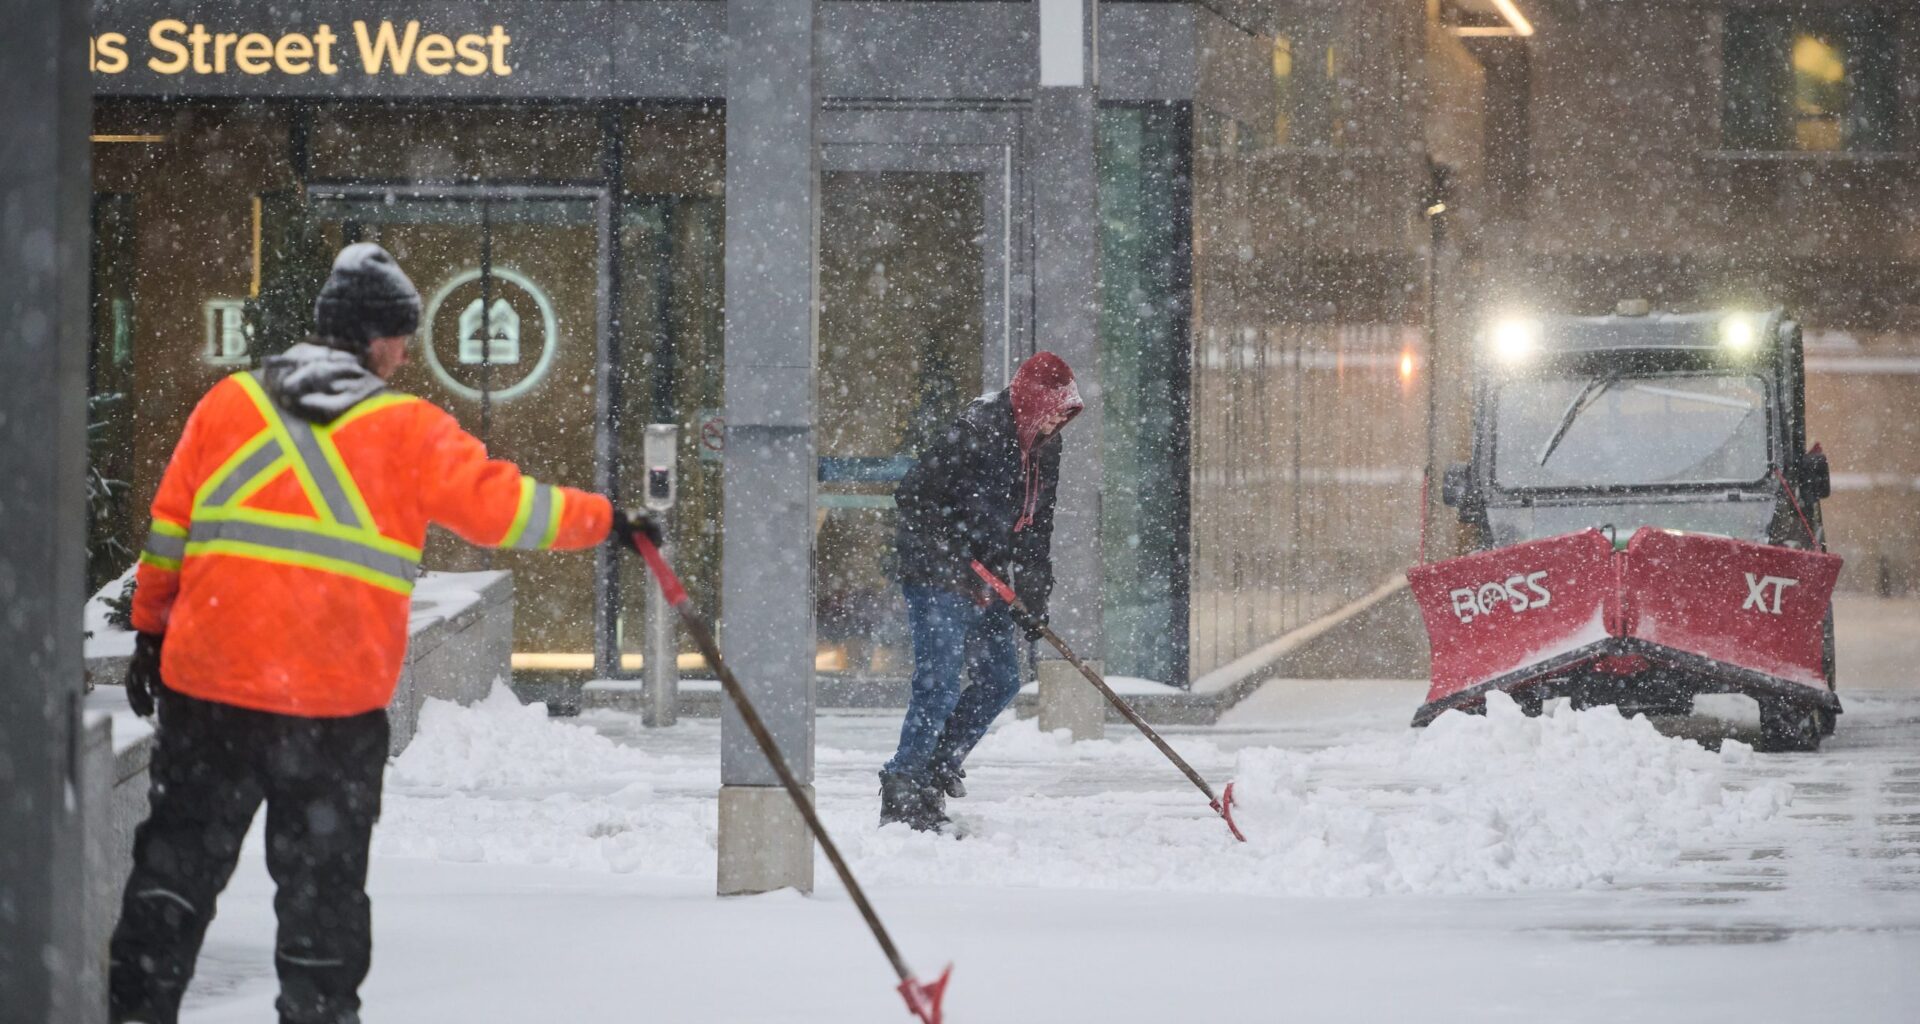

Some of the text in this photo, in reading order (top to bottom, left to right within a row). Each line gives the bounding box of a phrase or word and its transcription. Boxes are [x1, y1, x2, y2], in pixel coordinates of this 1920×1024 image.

[148, 19, 338, 75] Street
[353, 20, 512, 76] West
[1450, 570, 1551, 623] BOSS
[1742, 572, 1799, 615] XT
